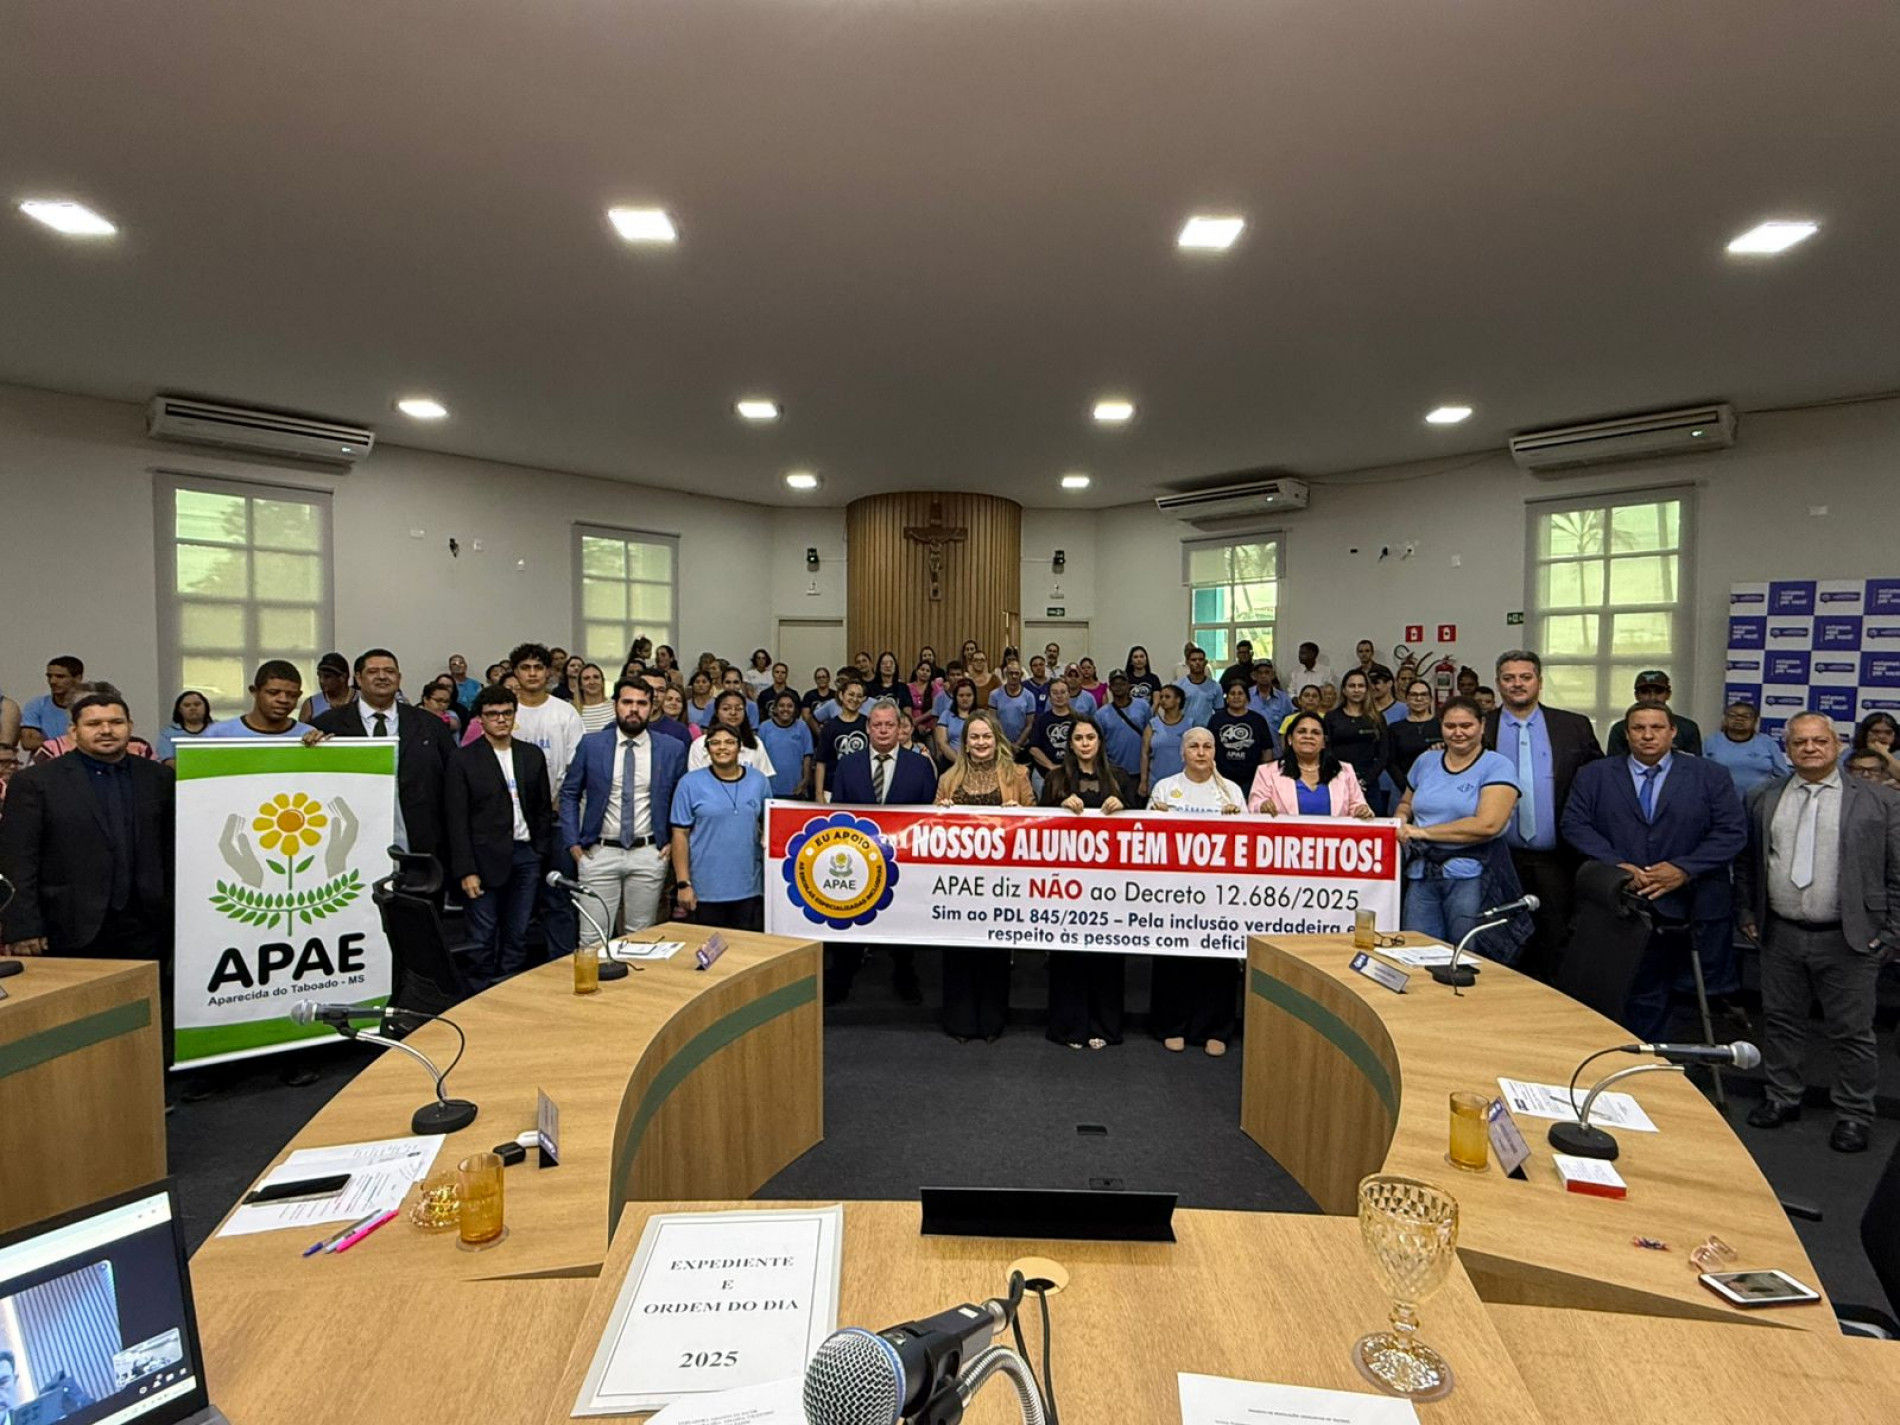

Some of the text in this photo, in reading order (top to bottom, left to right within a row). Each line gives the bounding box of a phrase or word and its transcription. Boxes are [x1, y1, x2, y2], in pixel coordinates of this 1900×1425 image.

[815, 830, 870, 850] EU APOIO
[911, 821, 1383, 874] NOSSOS ALUNOS TÊM VOZ E DIREITOS!
[823, 878, 857, 891] APAE
[931, 872, 1360, 911] APAE diz NÃO ao Decreto 12.686/2025
[931, 905, 962, 920] Sim
[967, 909, 988, 922] ao
[993, 907, 1025, 923] PDL
[1029, 908, 1109, 926] 845/2025
[1128, 913, 1164, 929] Pela
[1170, 914, 1239, 931] inclusão
[1244, 918, 1341, 934] verdadeira
[988, 927, 1247, 951] respeito às pessoas com defici
[207, 932, 366, 993] APAE
[207, 989, 269, 1006] Aparecida
[272, 984, 288, 997] do
[291, 978, 338, 994] Taboado
[347, 974, 365, 985] MS
[670, 1255, 795, 1271] EXPEDIENTE
[721, 1279, 735, 1291] E
[643, 1299, 799, 1315] ORDEM DO DIA
[678, 1350, 740, 1369] 2025
